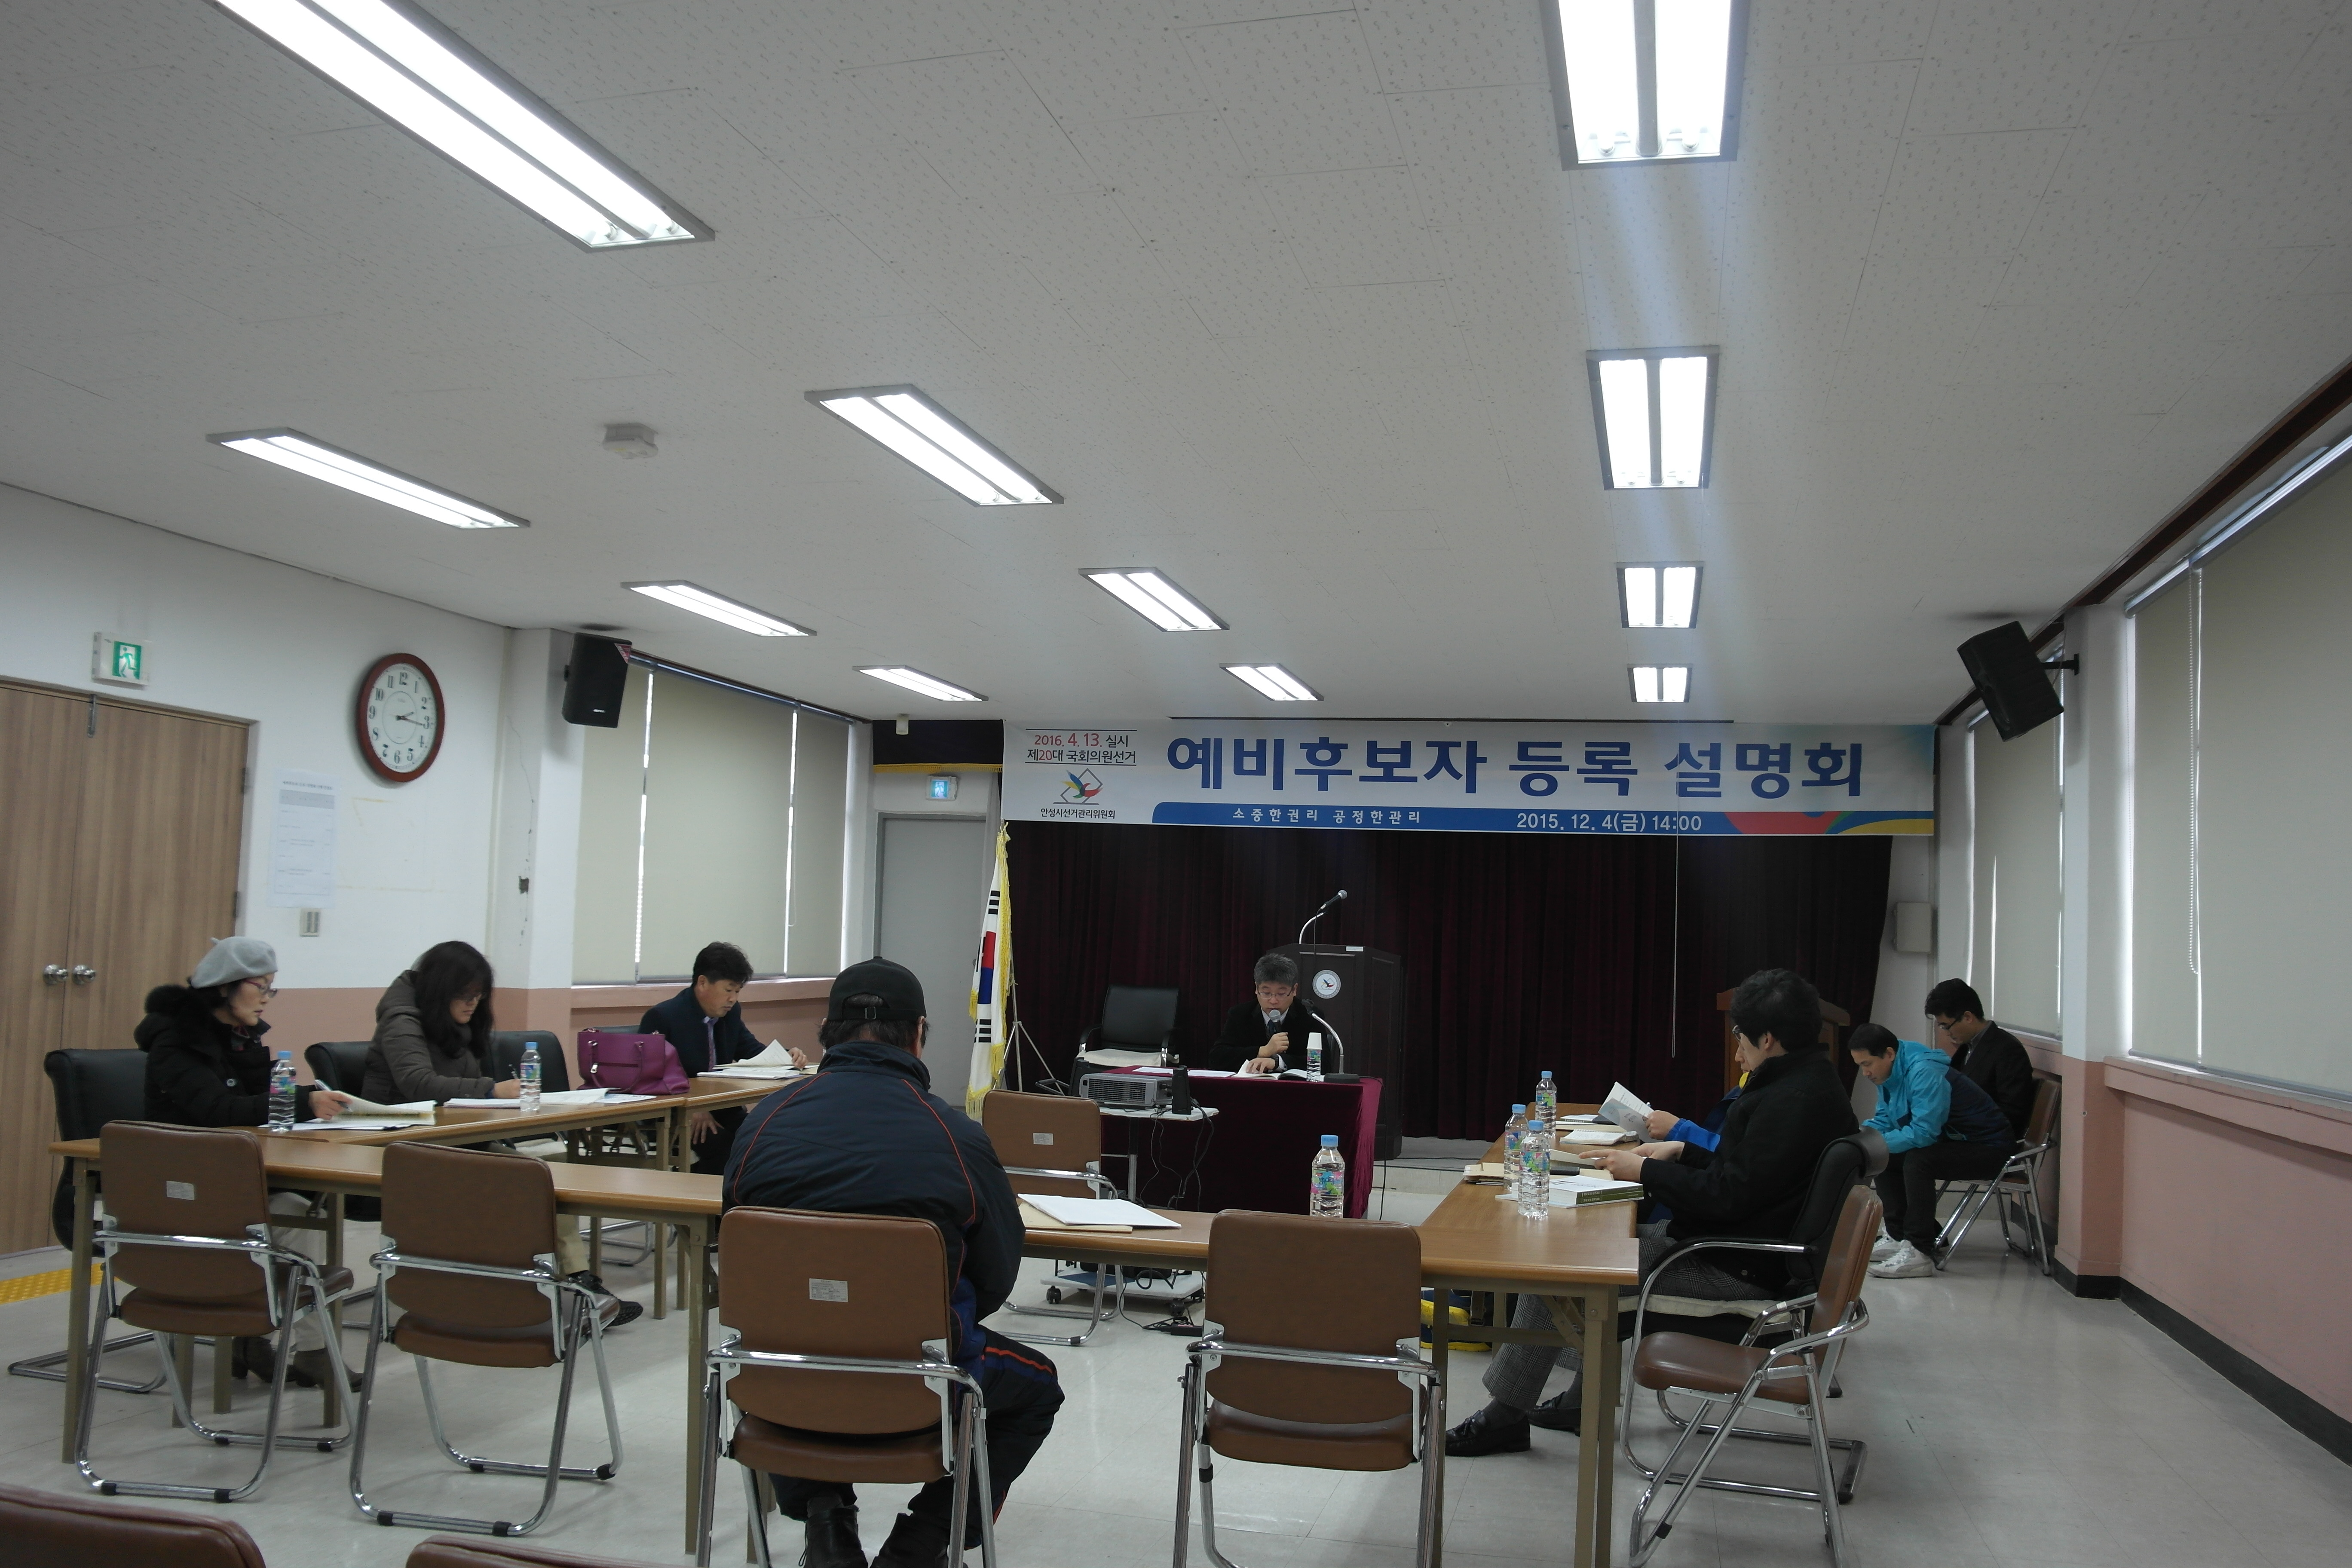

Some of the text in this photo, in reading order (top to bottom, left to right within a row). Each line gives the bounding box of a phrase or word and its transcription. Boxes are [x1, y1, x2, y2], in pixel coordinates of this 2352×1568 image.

[387, 675, 394, 688] 11
[399, 672, 408, 685] 12
[414, 680, 417, 693] 1
[375, 688, 384, 701] 10
[421, 697, 427, 710] 2
[369, 705, 376, 720] 9
[423, 716, 429, 729] 3
[372, 727, 379, 741] 8
[1034, 732, 1128, 748] 2016. 4. 13. 실시
[419, 735, 424, 748] 4
[383, 744, 389, 757] 7
[394, 750, 401, 764] 6
[407, 747, 413, 761] 5
[1027, 749, 1136, 763] 제20대 국회의원선거
[1167, 736, 1862, 799] 예비후보자 등록 설명회
[1041, 808, 1115, 819] 안성시선거관리위원회
[1516, 812, 1702, 832] 2015. 12. 4(금) 14:00
